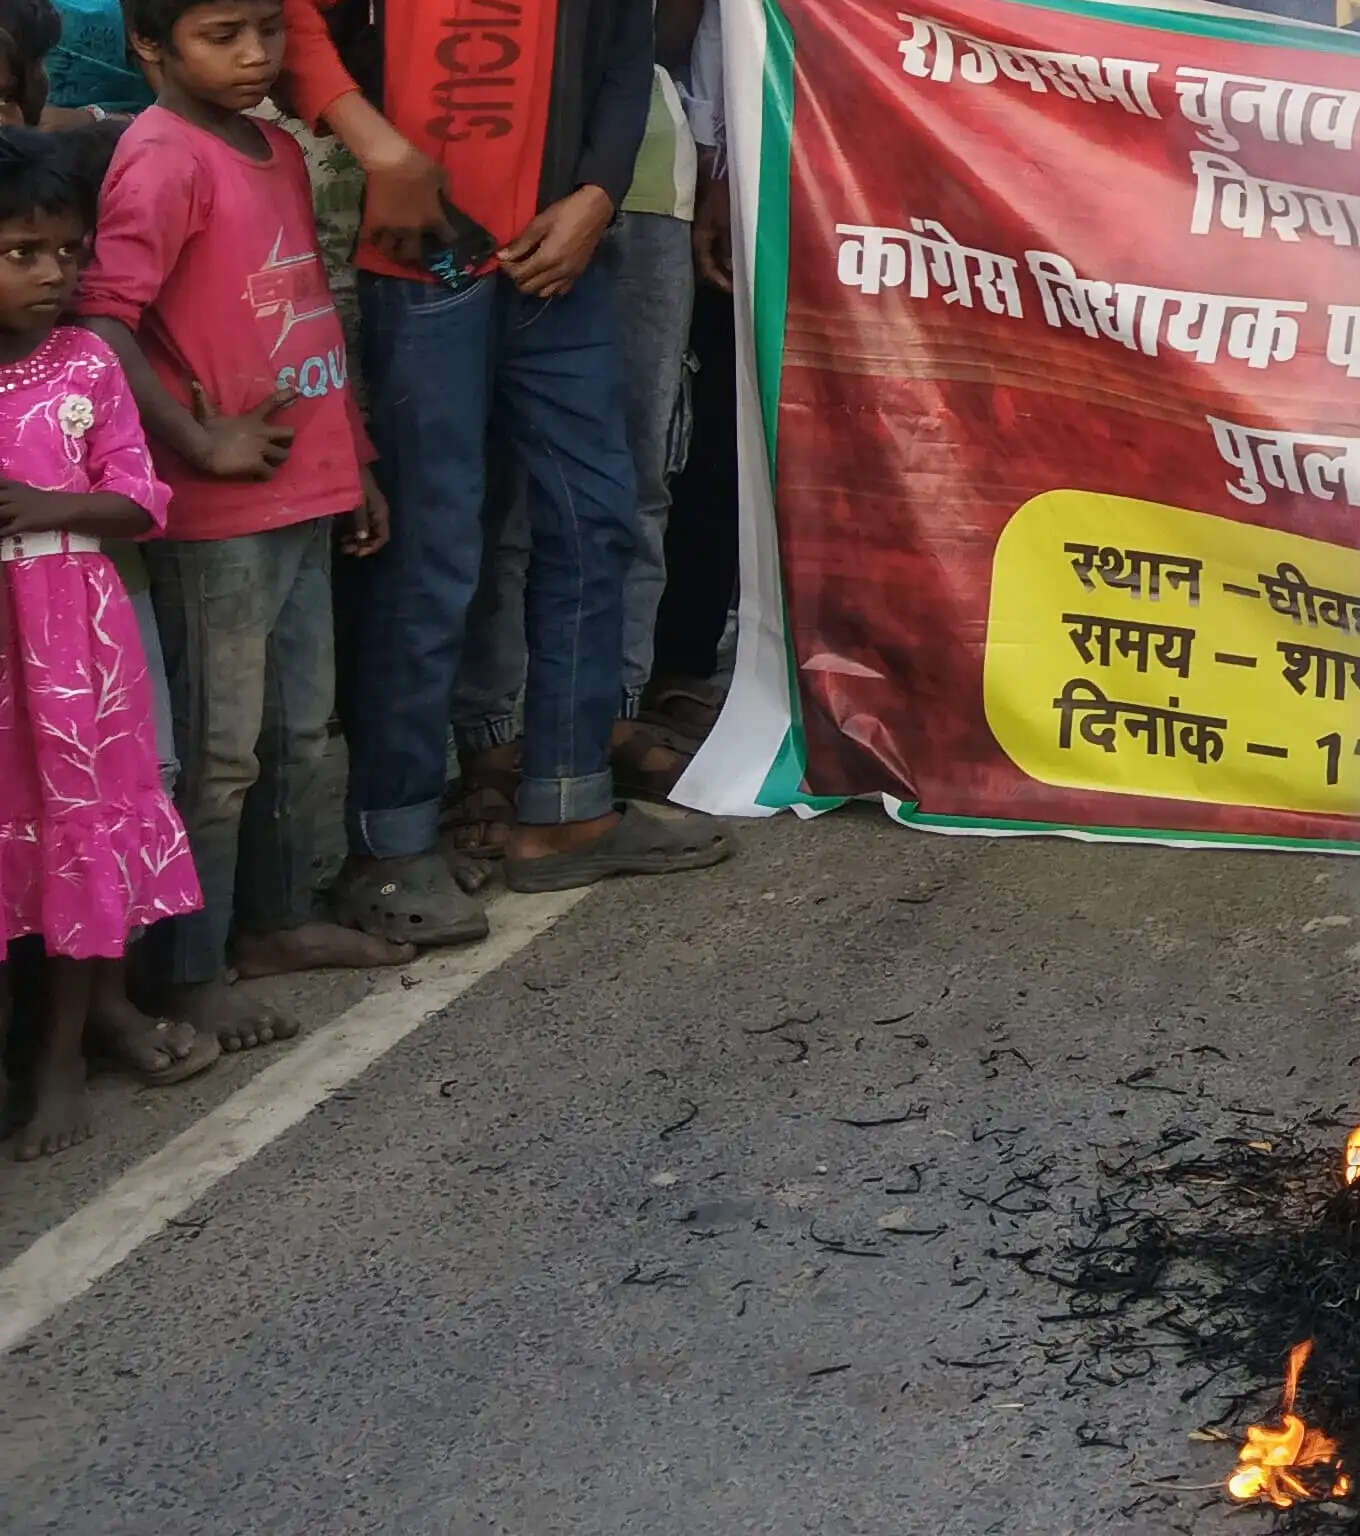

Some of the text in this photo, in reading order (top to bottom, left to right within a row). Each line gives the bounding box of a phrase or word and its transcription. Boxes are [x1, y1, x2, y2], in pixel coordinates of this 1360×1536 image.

[897, 12, 1162, 119] राज्यसभा
[835, 217, 1024, 318] कांग्रेस
[1024, 249, 1307, 369] विधायक
[1064, 542, 1203, 608] स्थान
[1062, 613, 1195, 679] समय
[1053, 678, 1228, 765] दिनांक
